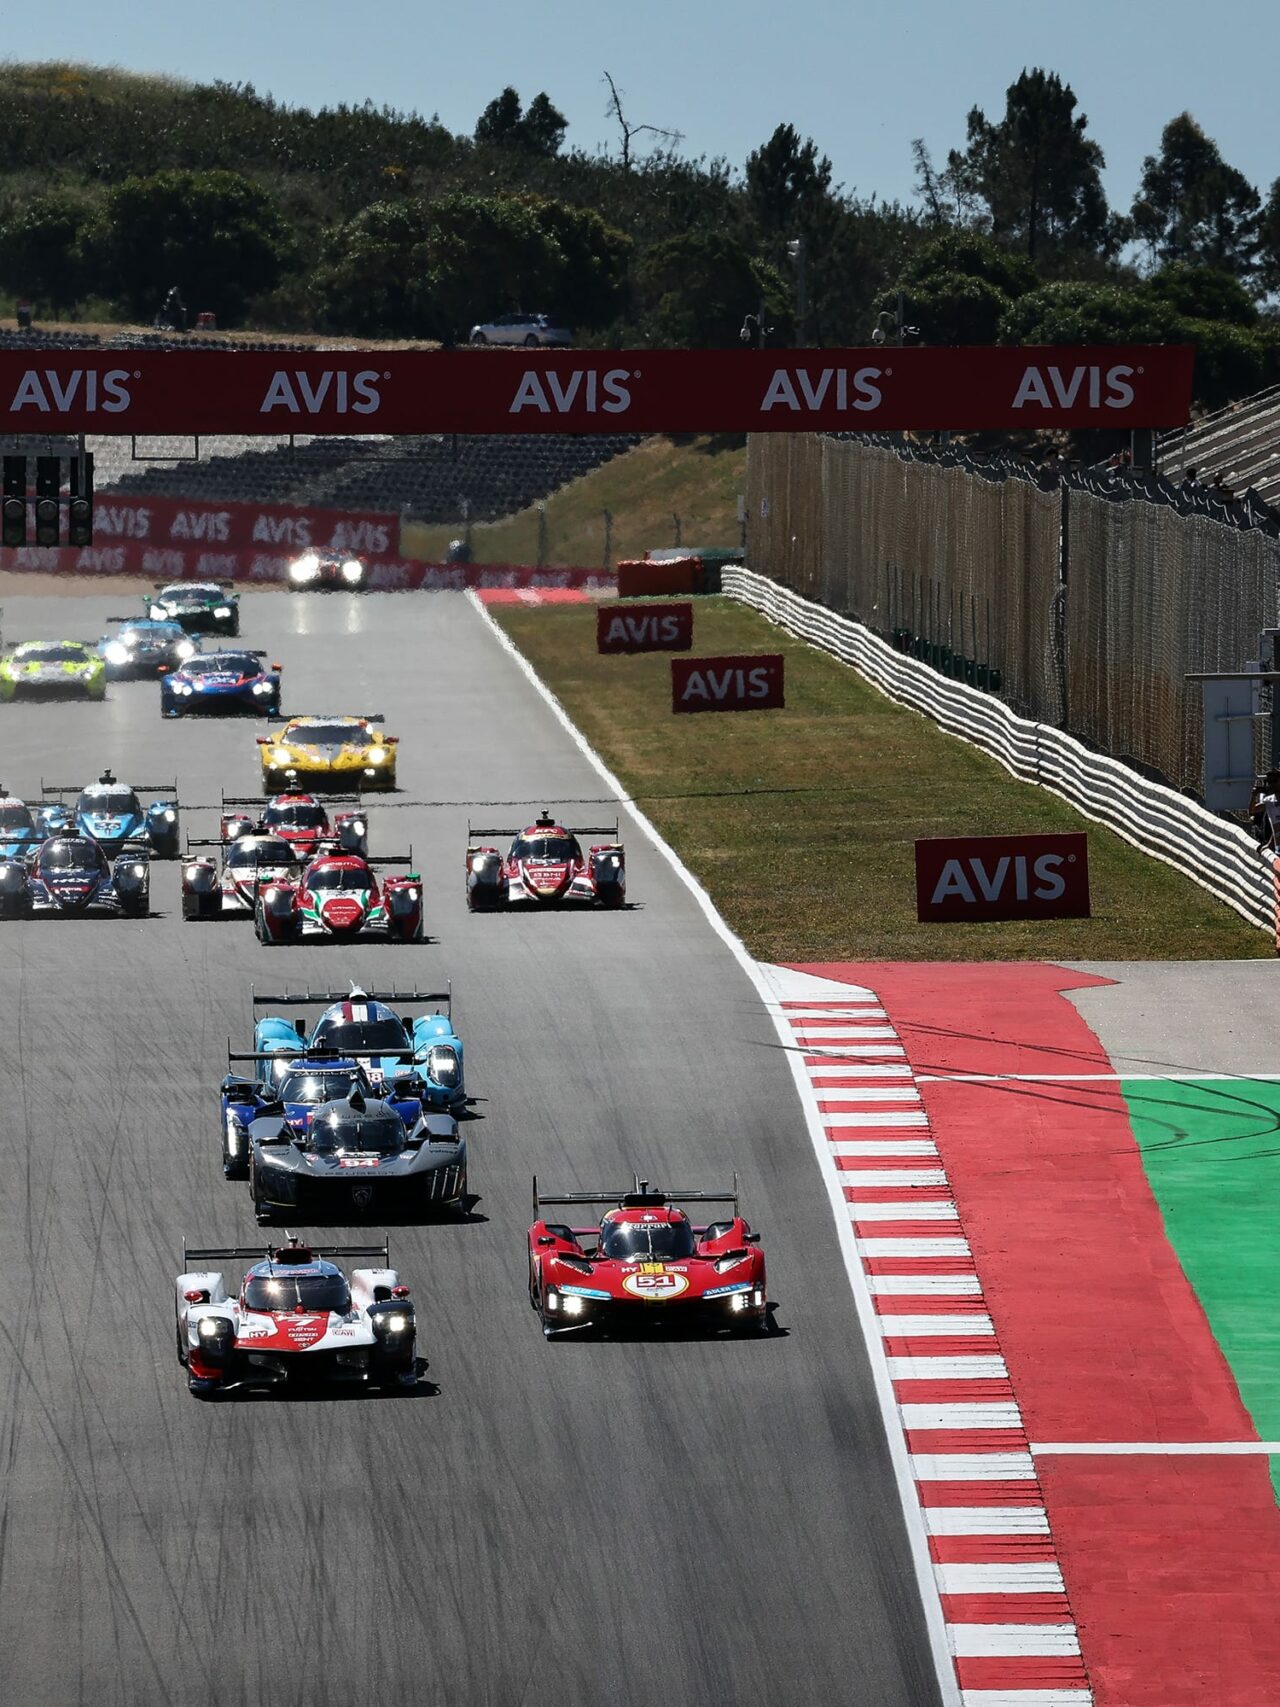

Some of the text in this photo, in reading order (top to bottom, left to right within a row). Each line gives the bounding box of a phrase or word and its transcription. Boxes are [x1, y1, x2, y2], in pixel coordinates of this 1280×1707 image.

[10, 369, 130, 413] AVIS
[260, 370, 380, 414] AVIS
[510, 369, 631, 413] AVIS
[761, 367, 881, 411] AVIS
[1012, 365, 1134, 409] AVIS
[93, 505, 151, 538] AVIS
[169, 511, 230, 542] AVIS
[604, 615, 682, 642] AVIS
[682, 668, 769, 702] AVIS
[931, 854, 1066, 904] AVIS
[344, 1160, 375, 1168] 94
[637, 1275, 675, 1287] 51
